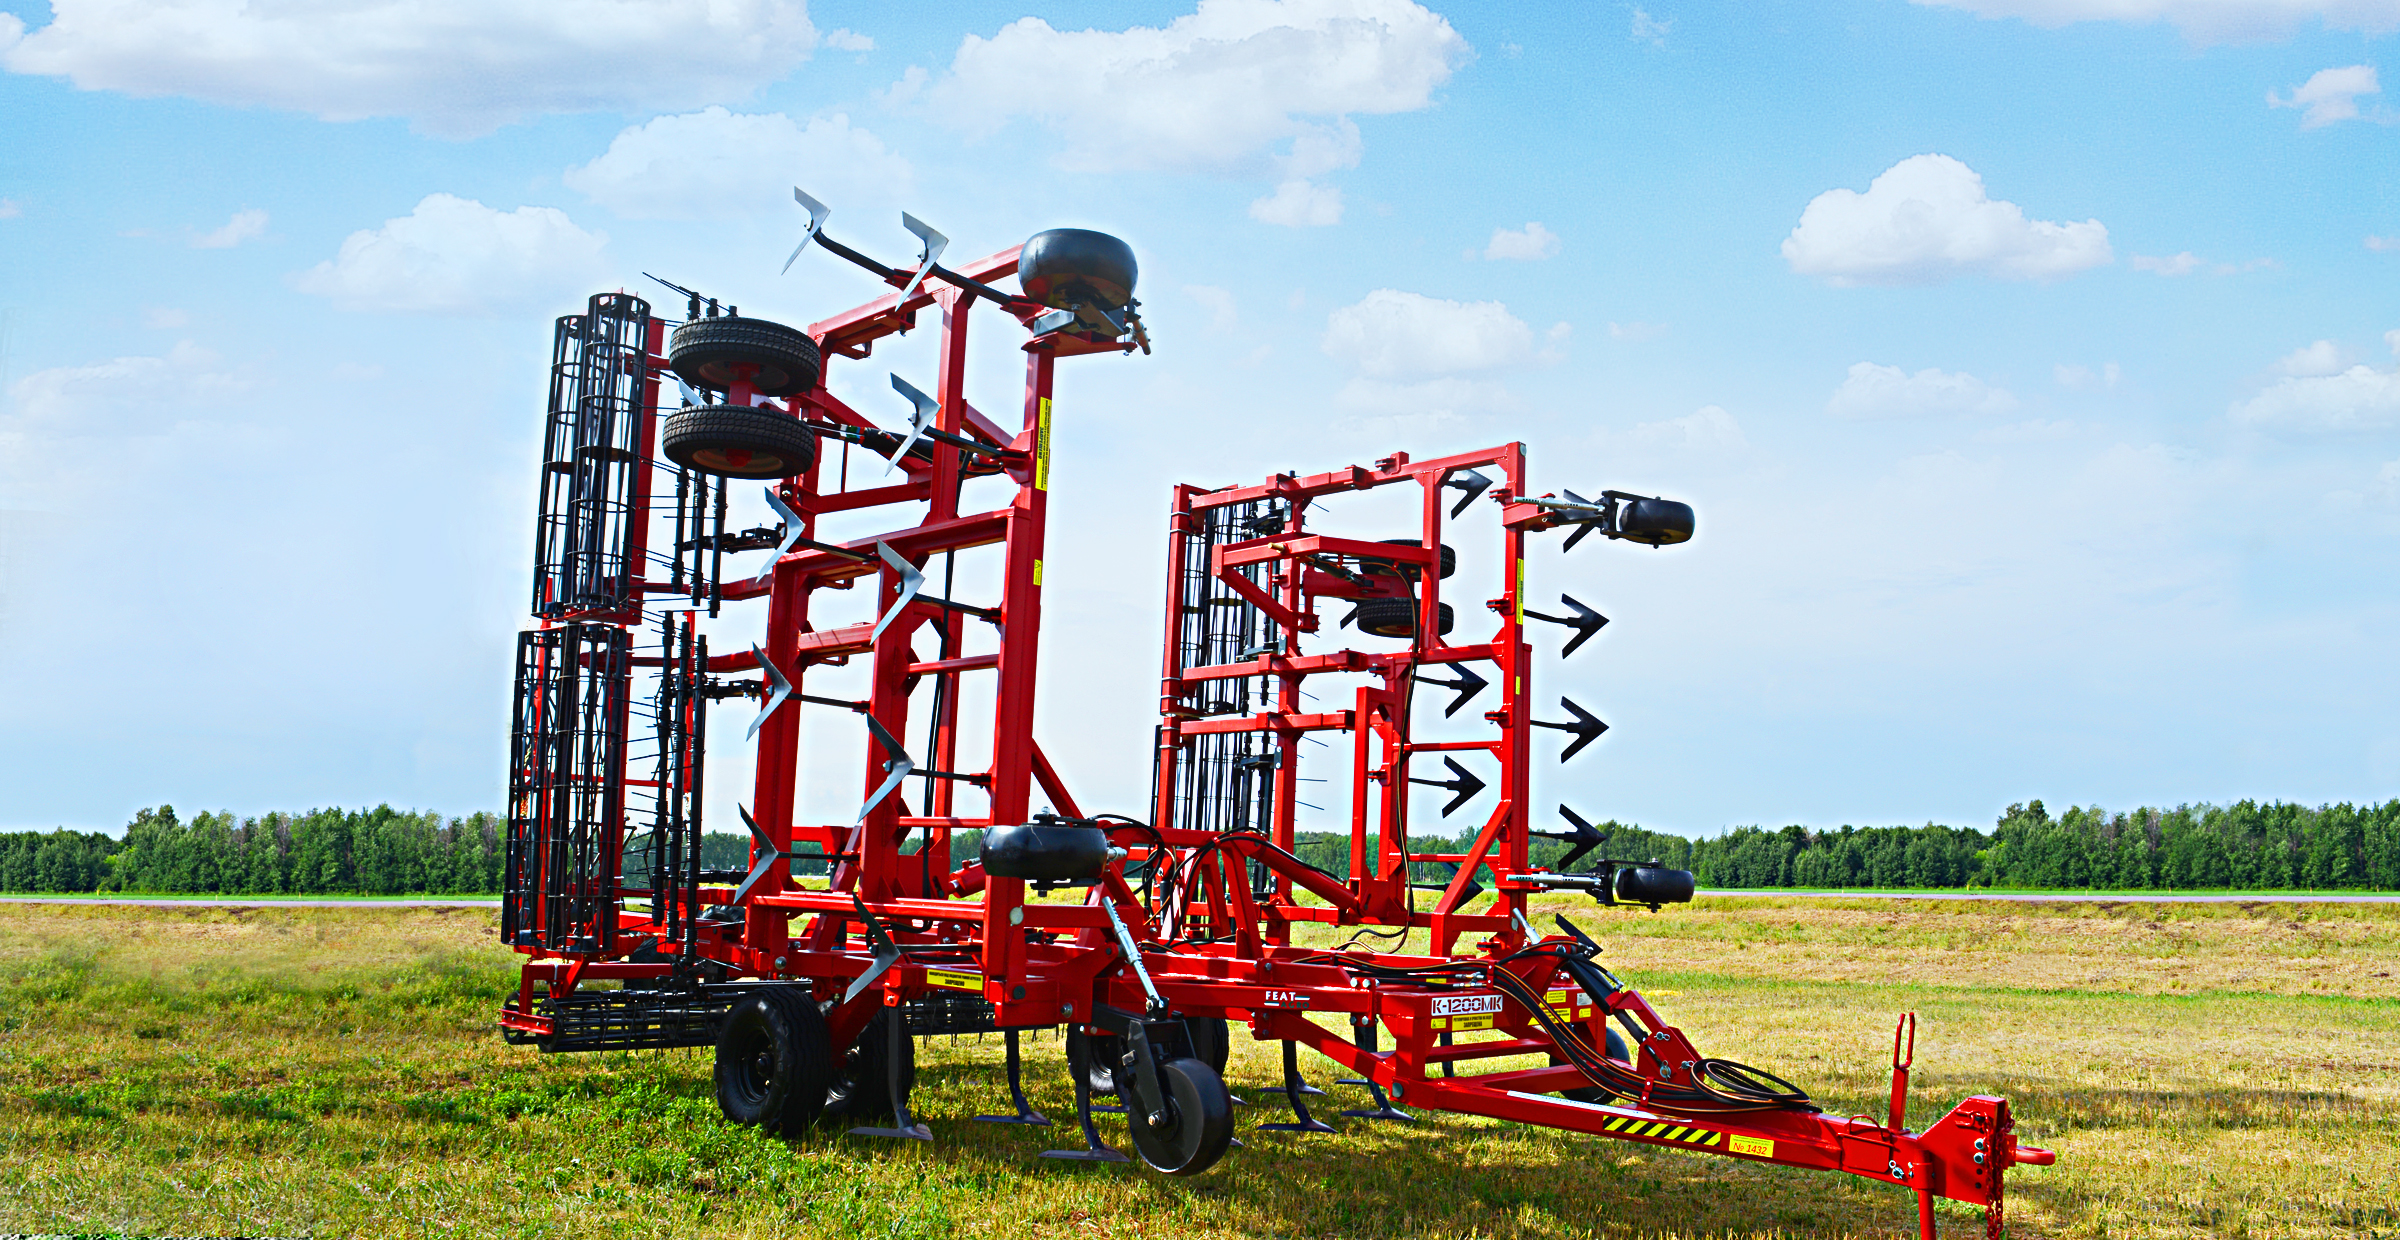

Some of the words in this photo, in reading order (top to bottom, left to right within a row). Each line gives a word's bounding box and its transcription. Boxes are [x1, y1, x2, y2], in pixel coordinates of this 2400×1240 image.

[1265, 990, 1296, 1001] FEAT
[1280, 1001, 1310, 1009] AGRO
[1746, 1144, 1767, 1155] 1432
